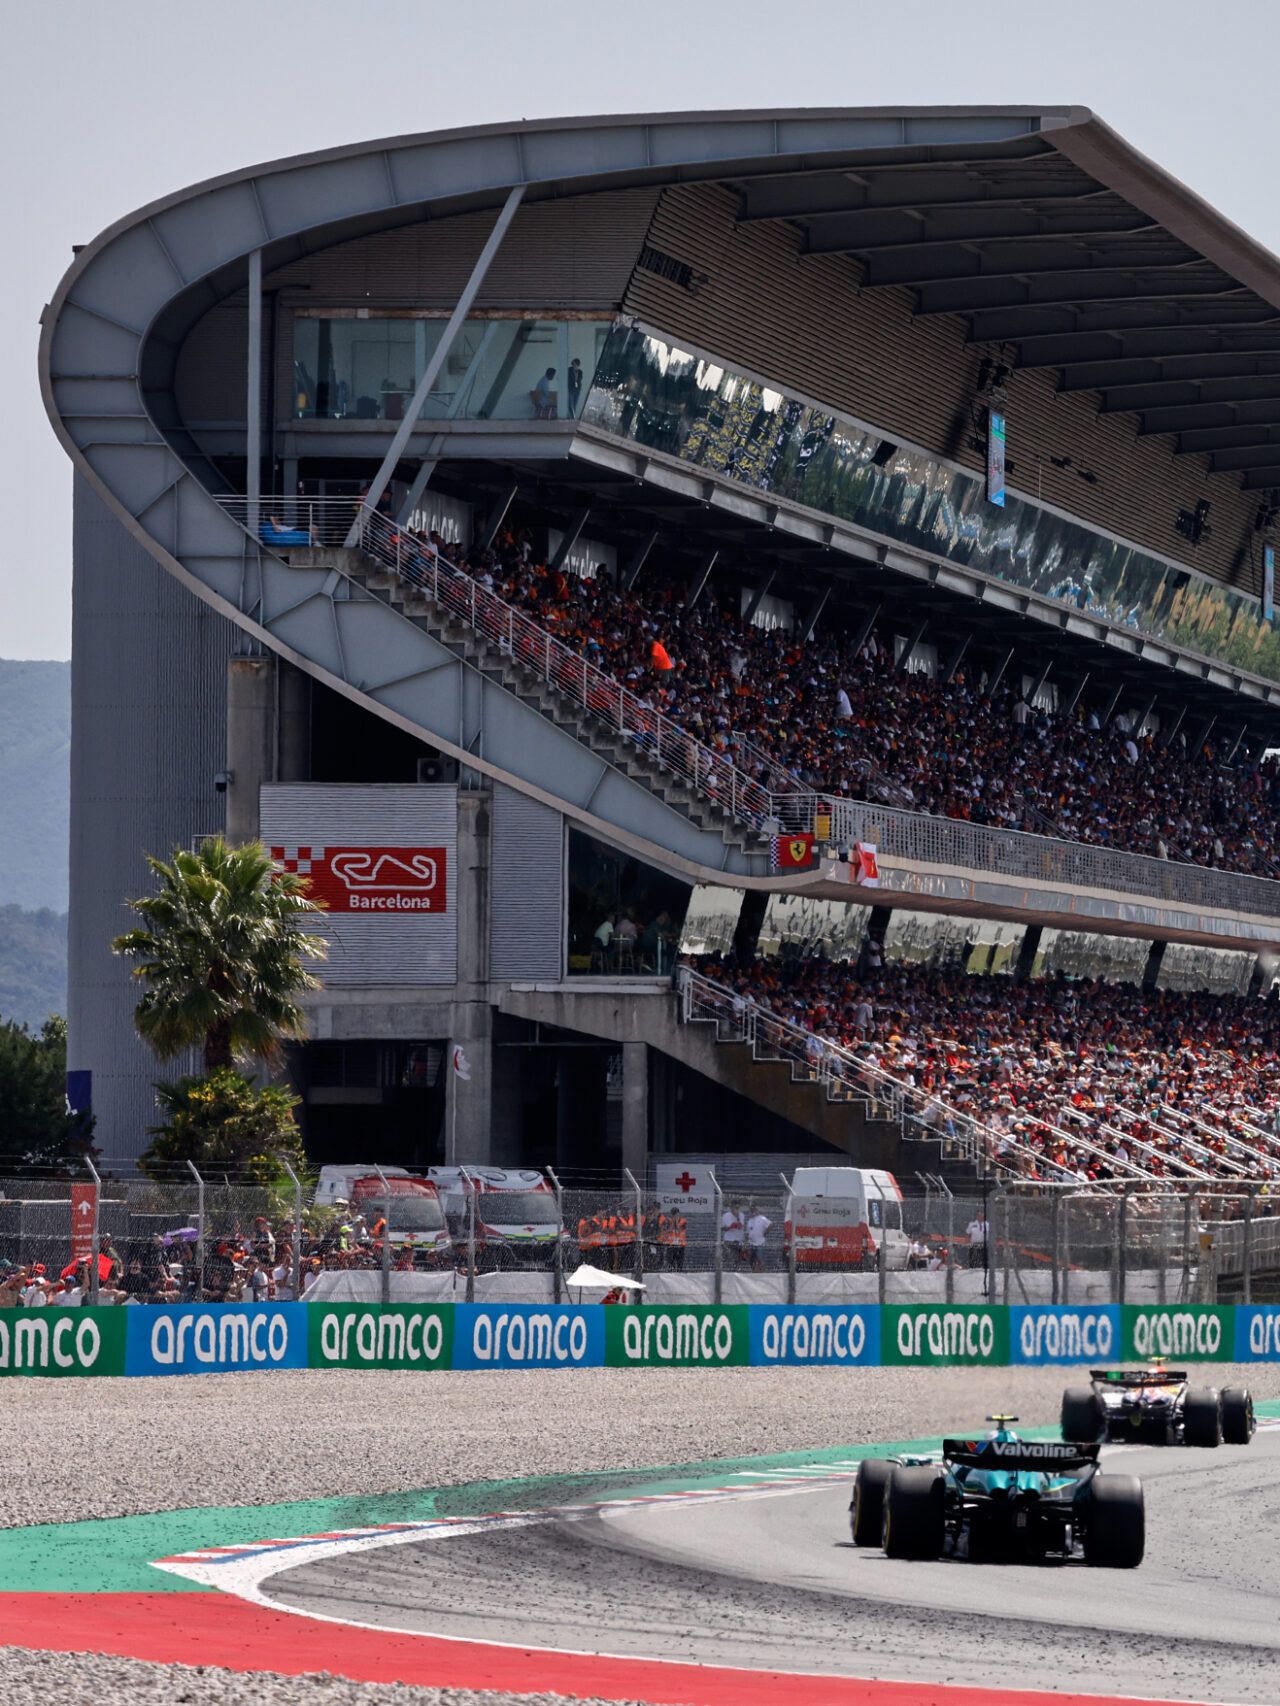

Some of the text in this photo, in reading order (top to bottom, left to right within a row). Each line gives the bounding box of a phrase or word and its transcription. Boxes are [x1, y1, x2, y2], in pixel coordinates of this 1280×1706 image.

[350, 893, 431, 909] Barcelona
[151, 1314, 288, 1364] aramco
[320, 1314, 442, 1361] aramco
[473, 1315, 587, 1360] aramco
[624, 1314, 732, 1360] aramco
[763, 1314, 866, 1358] aramco
[898, 1313, 994, 1357] aramco
[1020, 1313, 1112, 1357] aramco
[1134, 1313, 1221, 1355] aramco
[992, 1442, 1078, 1458] Valvoline
